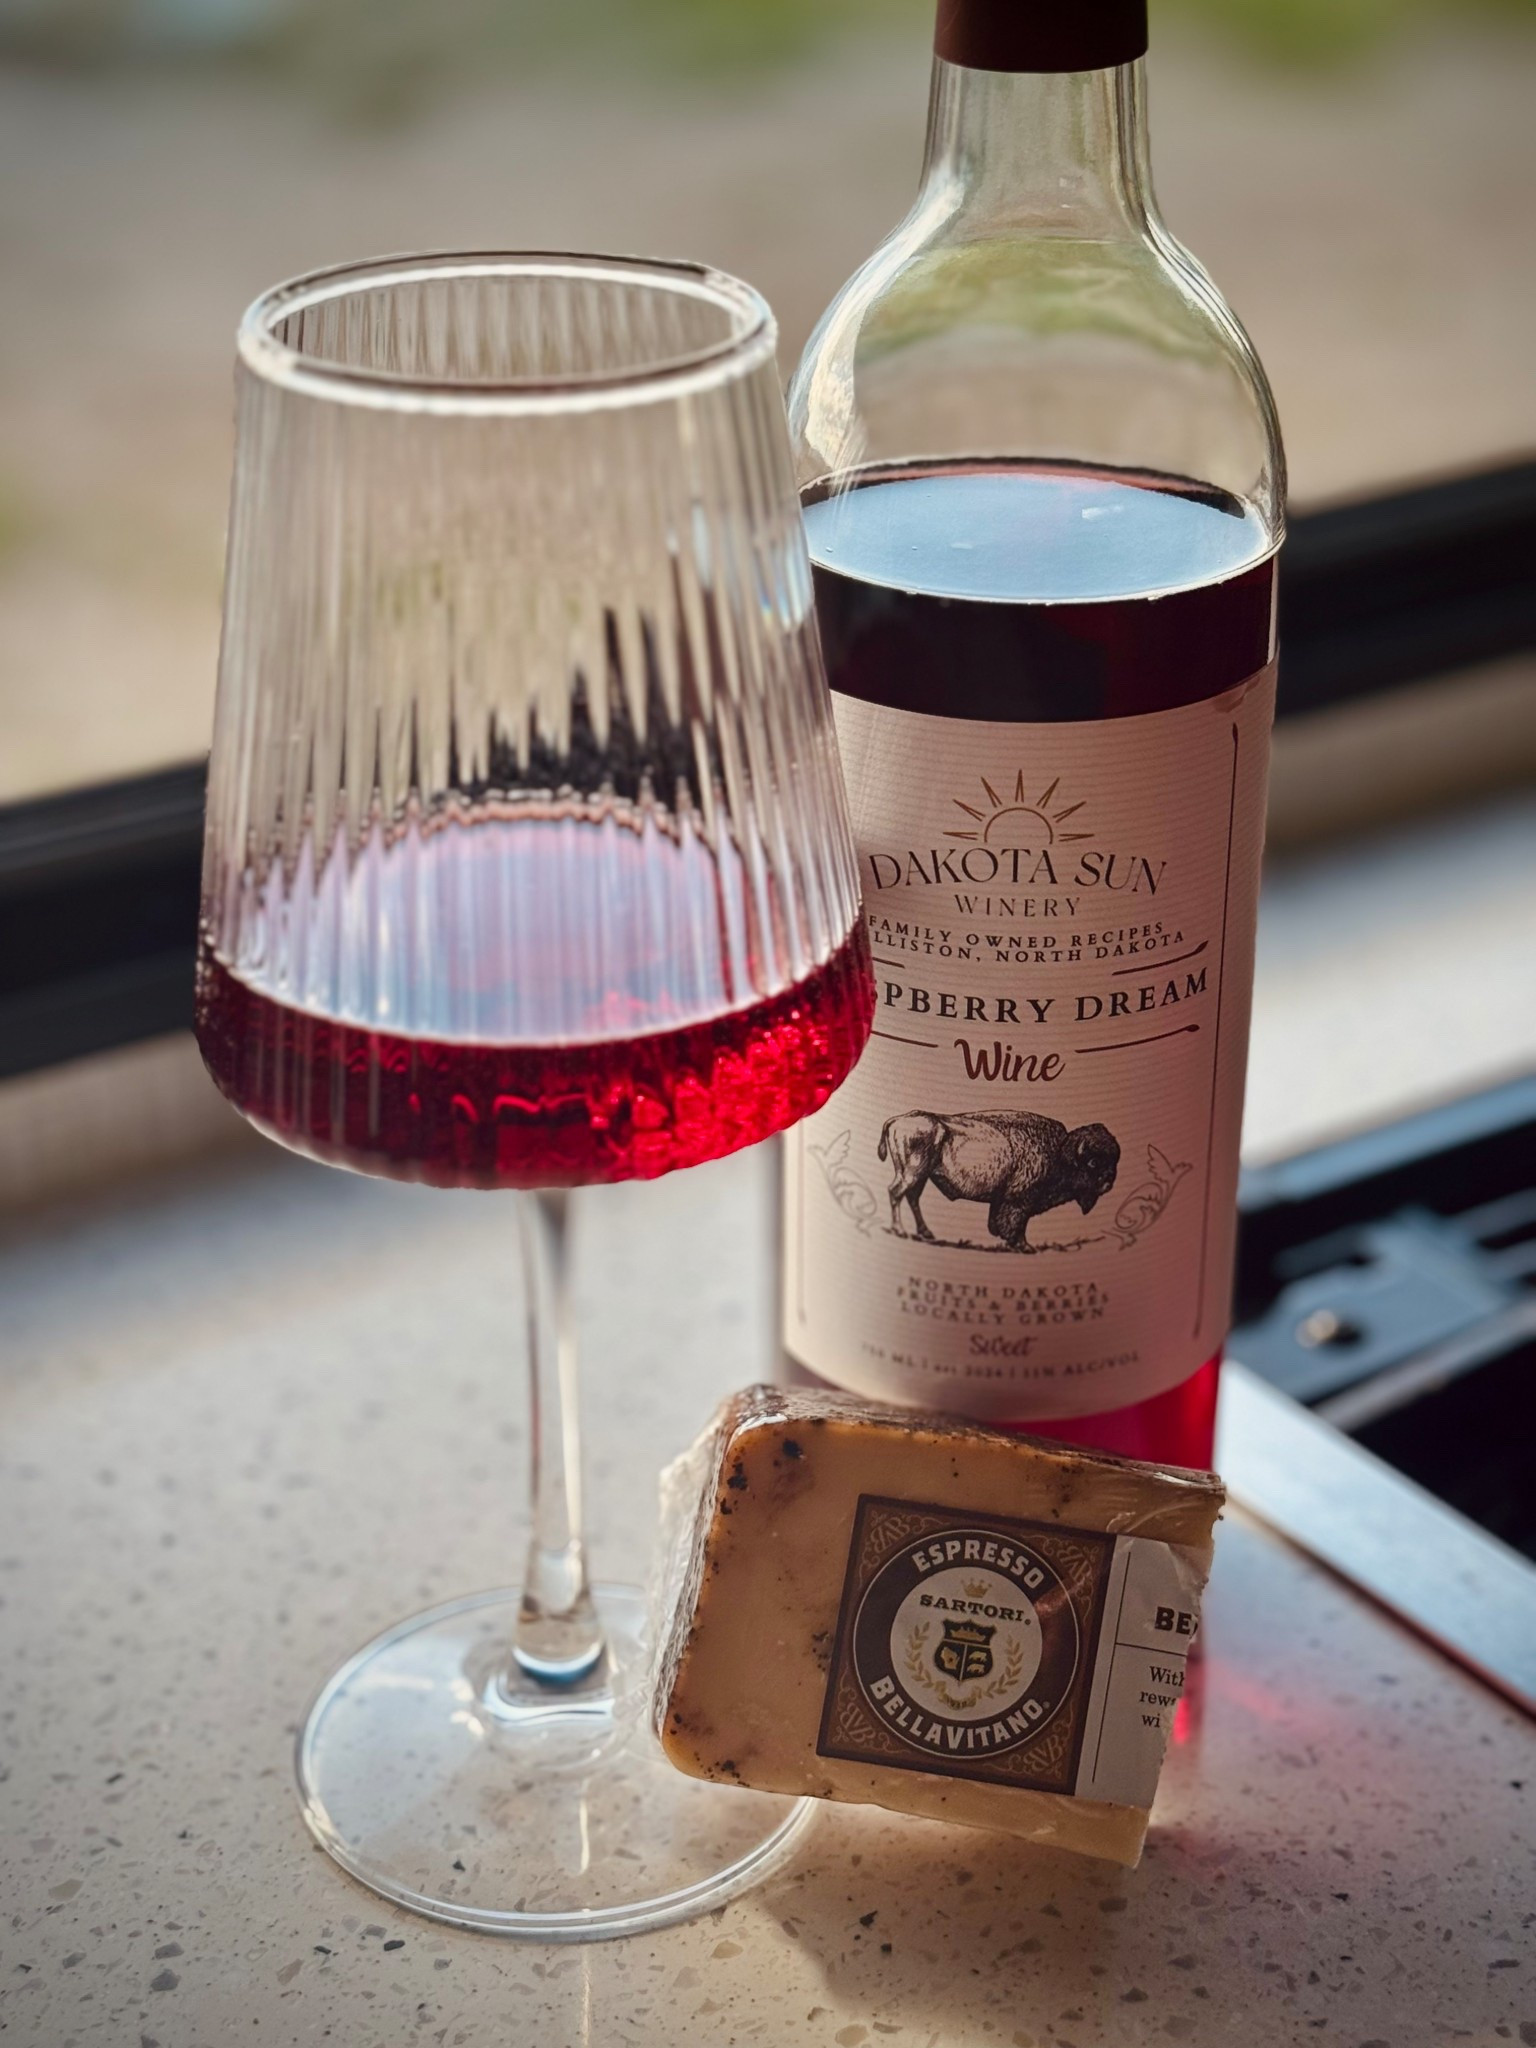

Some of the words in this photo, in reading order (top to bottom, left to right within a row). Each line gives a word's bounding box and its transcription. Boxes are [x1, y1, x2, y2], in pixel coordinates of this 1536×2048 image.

[868, 847, 1058, 890] DAKOTA
[1074, 851, 1168, 895] SUN
[953, 893, 1080, 917] WINERY
[868, 914, 952, 943] FAMILY
[965, 932, 1057, 949] OWNED
[1070, 921, 1164, 948] RECIPES
[995, 949, 1082, 963] NORTH
[1095, 930, 1185, 960] DAKOTA
[874, 979, 1056, 1024] PBERRY
[1074, 966, 1208, 1022] DREAM
[953, 1038, 1066, 1083] Wine
[896, 1286, 977, 1310] FRUITS
[1015, 1292, 1110, 1312] BERRIES
[908, 1275, 989, 1298] NORTH
[1001, 1281, 1099, 1299] DAKOTA
[900, 1300, 1006, 1325] LOCALLY
[1018, 1306, 1105, 1325] GROWN
[911, 1539, 1045, 1589] ESPRESSO
[1154, 1605, 1199, 1639] BE
[1139, 1690, 1177, 1707] rew
